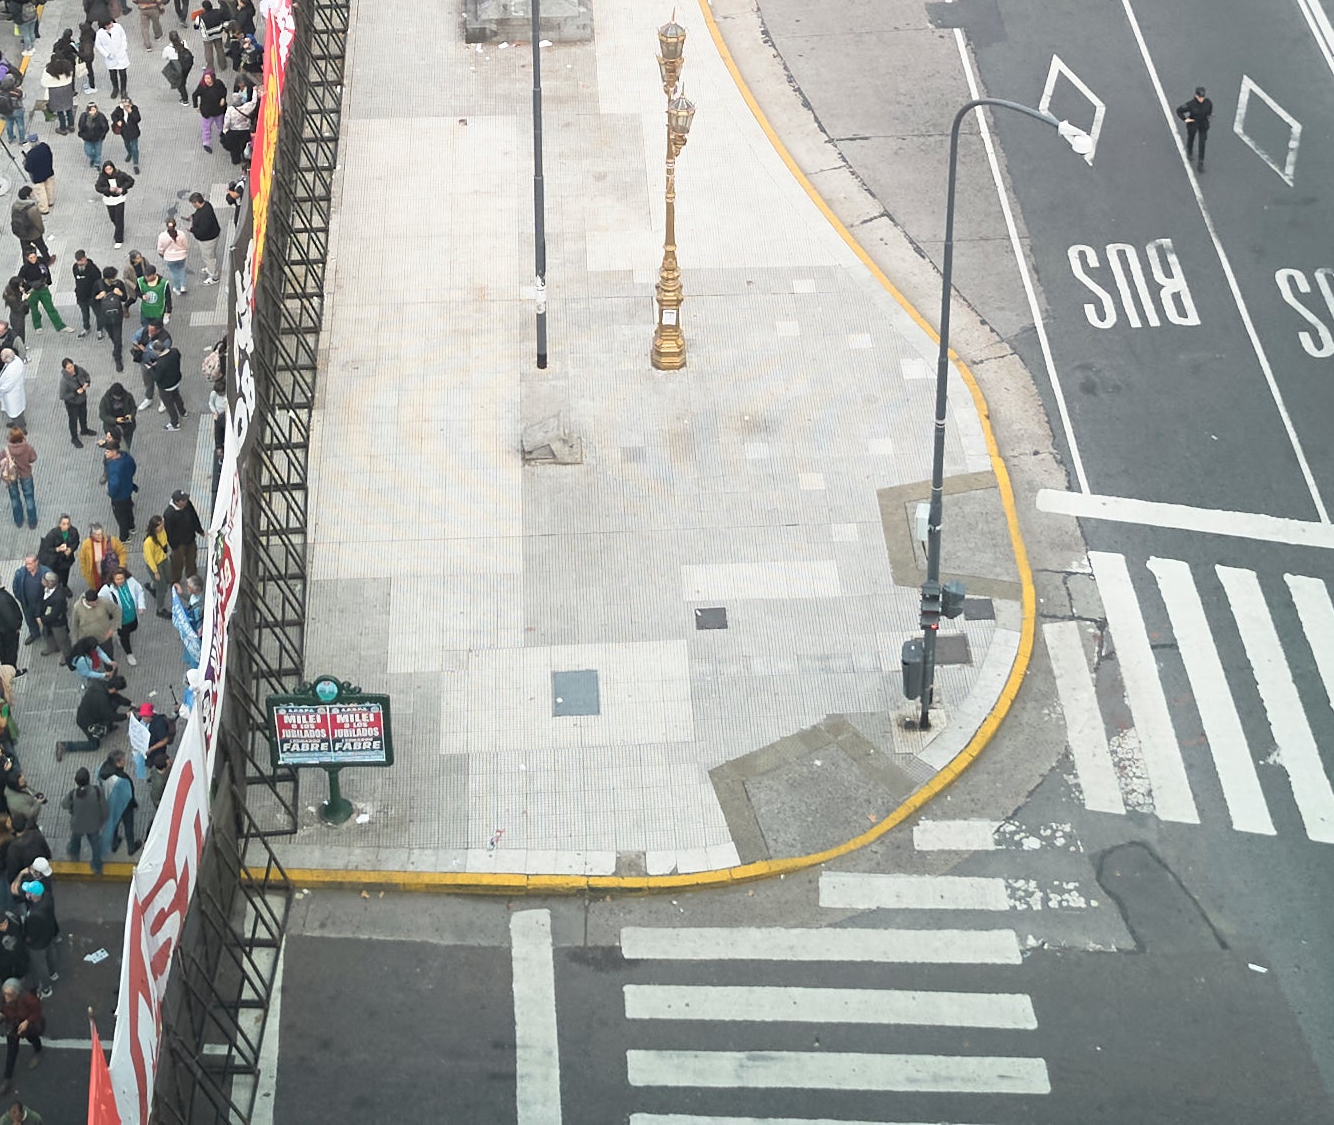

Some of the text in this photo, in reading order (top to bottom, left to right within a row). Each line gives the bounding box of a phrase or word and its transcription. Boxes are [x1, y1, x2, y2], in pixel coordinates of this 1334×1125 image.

[1067, 238, 1201, 330] BUS
[283, 714, 322, 724] MILEI
[336, 713, 375, 724] MILEI
[282, 728, 327, 739] JUBILADOS
[334, 727, 380, 738] JUBILADOS
[282, 742, 329, 752] FABRE
[334, 741, 381, 751] FABRE
